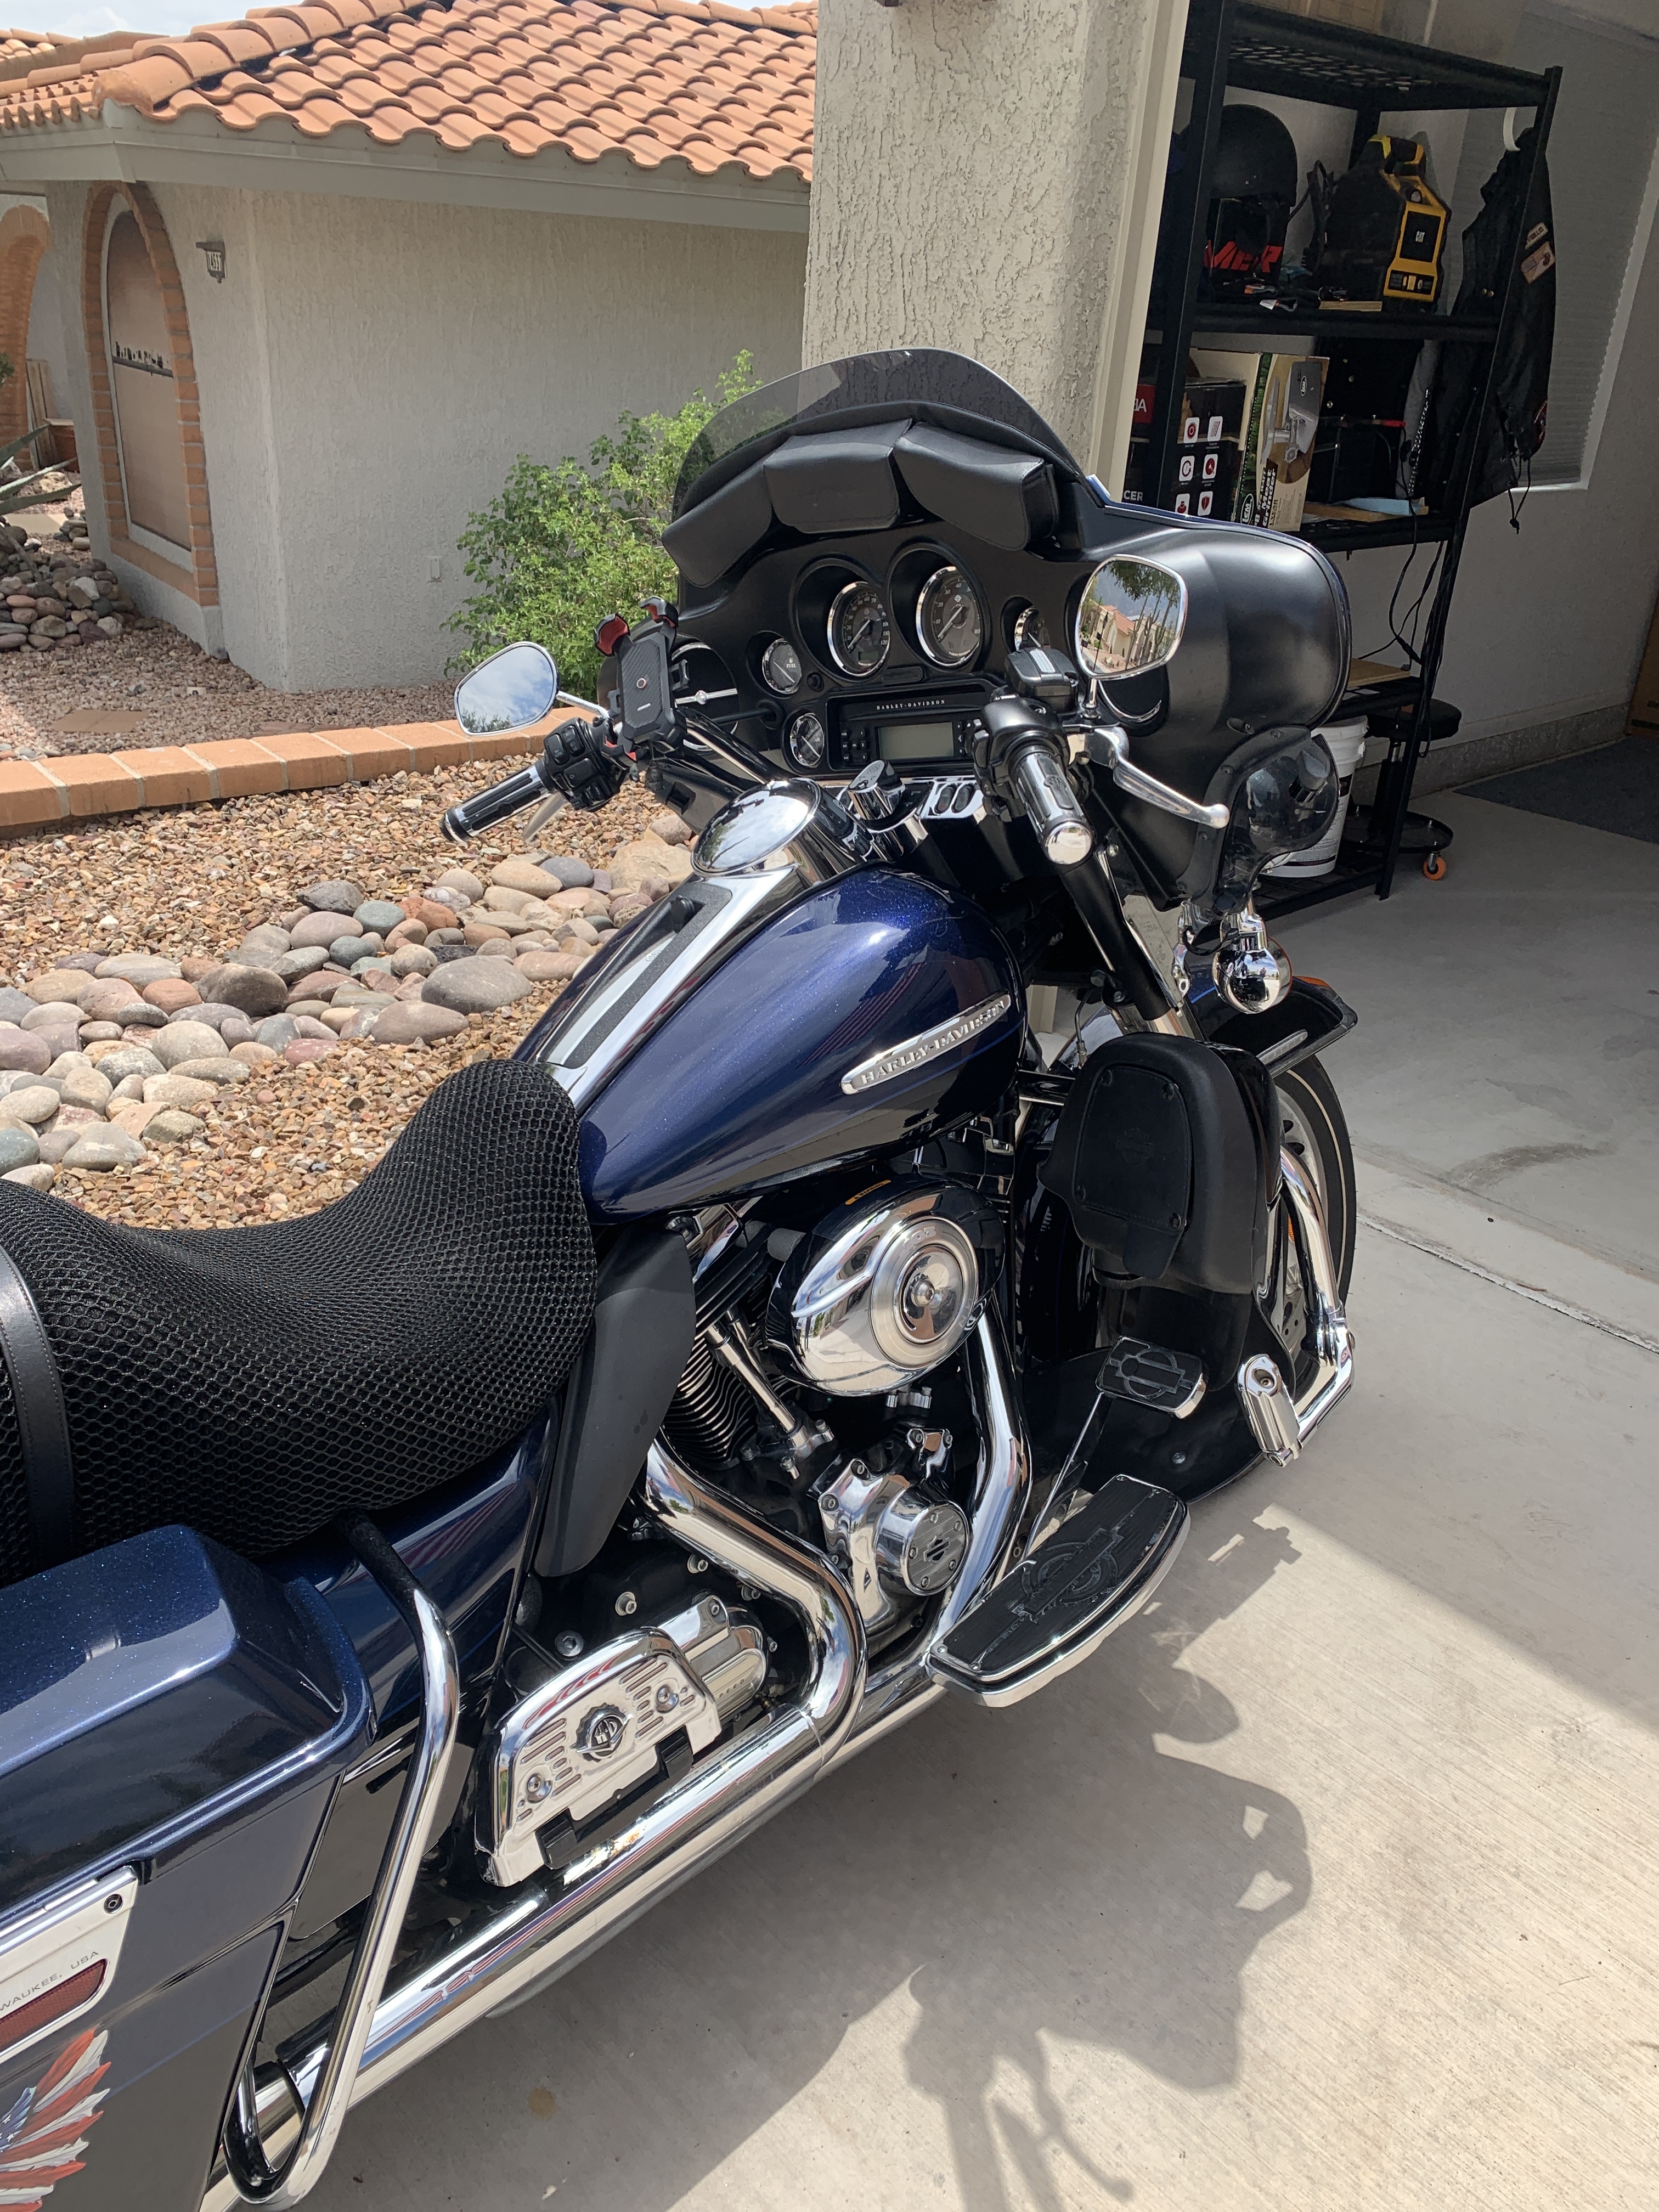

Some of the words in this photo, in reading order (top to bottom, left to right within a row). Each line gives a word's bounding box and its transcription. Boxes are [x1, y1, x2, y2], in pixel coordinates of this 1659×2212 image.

[877, 699, 945, 710] HARLEY-DAVIDSON
[861, 1000, 1005, 1084] HARLEY-DAVIDSON
[858, 1183, 884, 1196] WARNING
[902, 1226, 936, 1251] 103
[718, 1679, 745, 1699] PEED
[70, 1951, 99, 1970] USA
